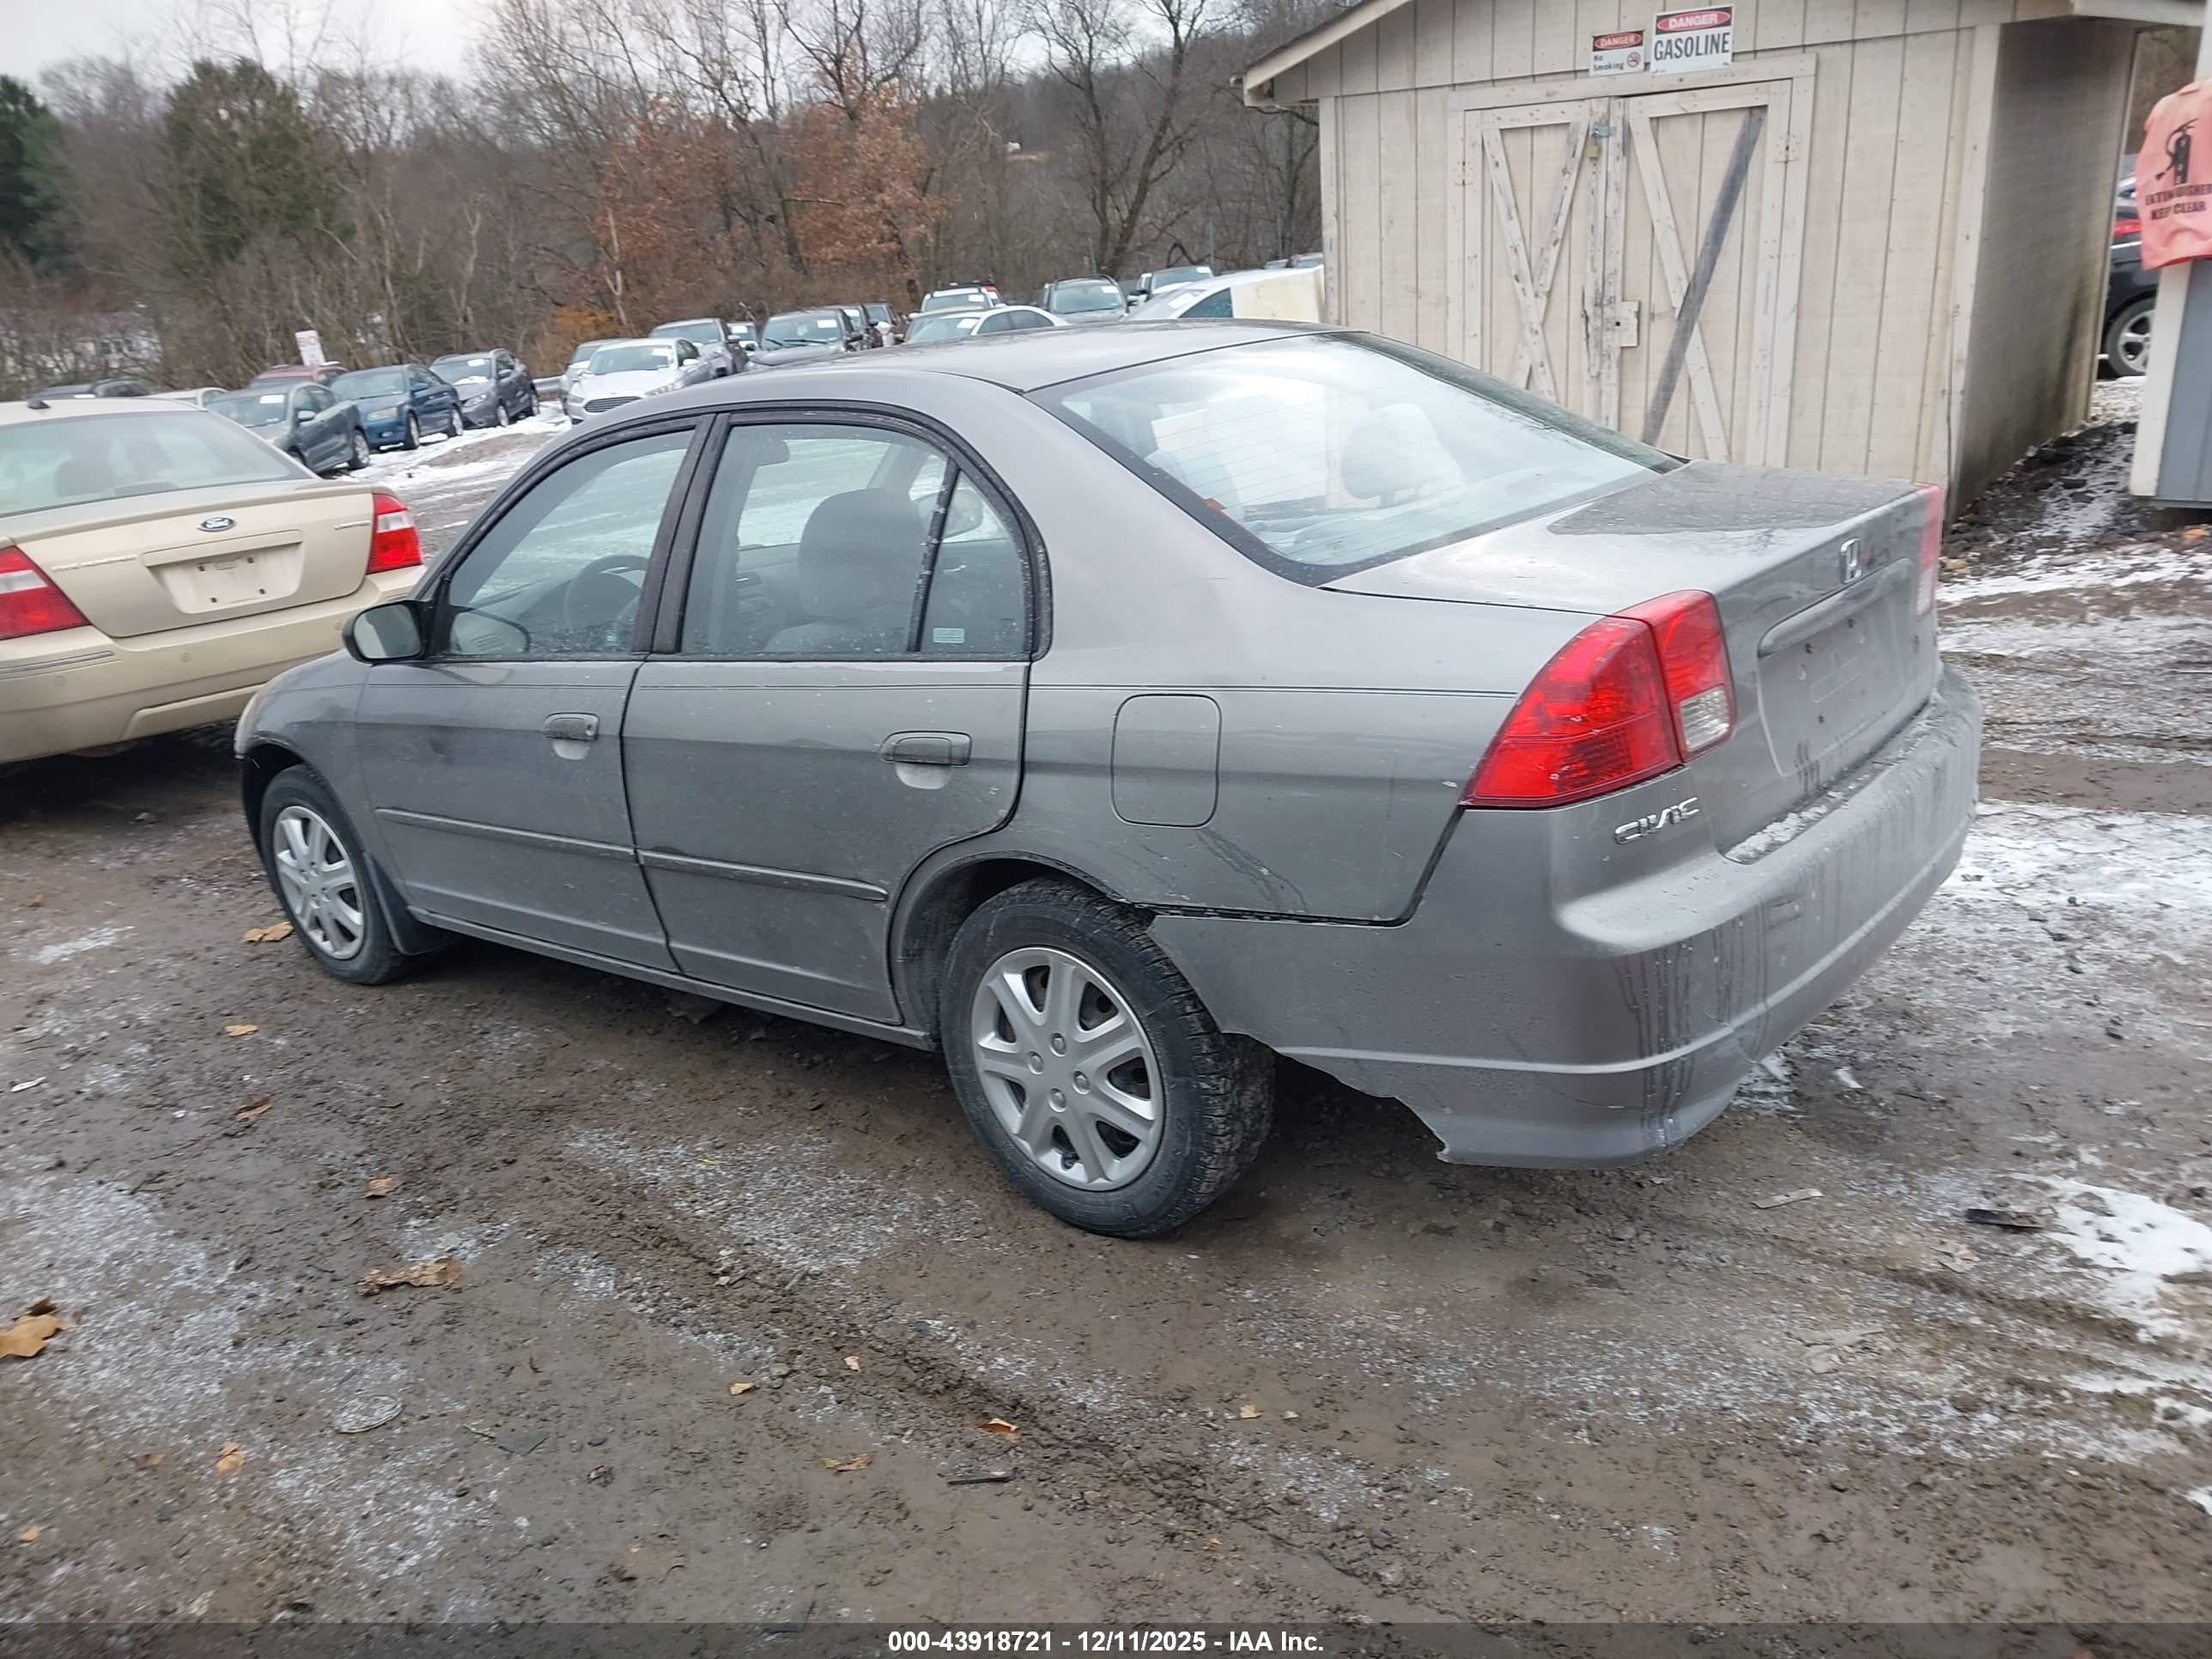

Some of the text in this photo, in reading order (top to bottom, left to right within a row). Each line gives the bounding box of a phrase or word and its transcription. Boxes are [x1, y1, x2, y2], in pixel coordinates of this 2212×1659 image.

[1668, 13, 1718, 28] DANGER
[1600, 35, 1635, 47] DANGER
[1654, 33, 1730, 61] GASOLINE
[1593, 62, 1625, 71] Smoking
[2173, 202, 2206, 215] CLEAR
[1614, 797, 1700, 844] CIVIC
